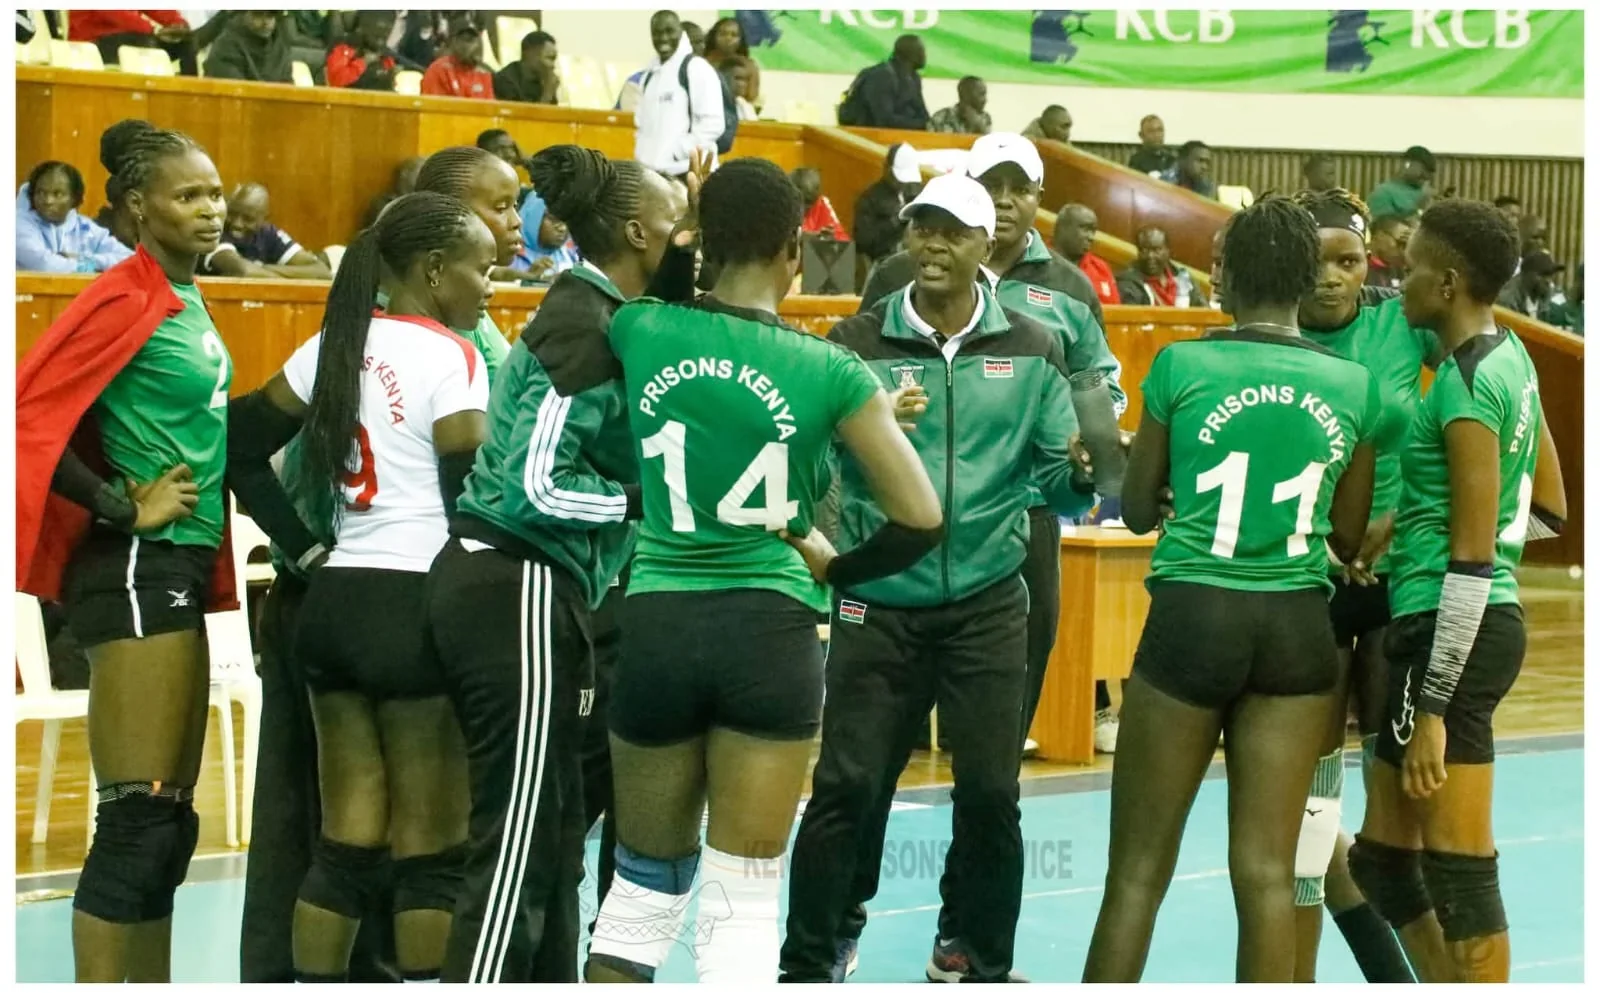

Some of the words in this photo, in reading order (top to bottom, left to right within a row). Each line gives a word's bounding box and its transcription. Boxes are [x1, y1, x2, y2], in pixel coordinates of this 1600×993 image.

[1411, 9, 1530, 49] KCB
[373, 360, 405, 425] KENYA
[640, 357, 733, 417] PRISONS
[737, 365, 797, 441] KENYA
[1198, 384, 1294, 445] PRISONS
[1300, 392, 1345, 464] KENYA
[640, 420, 800, 532] 14
[1196, 450, 1328, 559] 11
